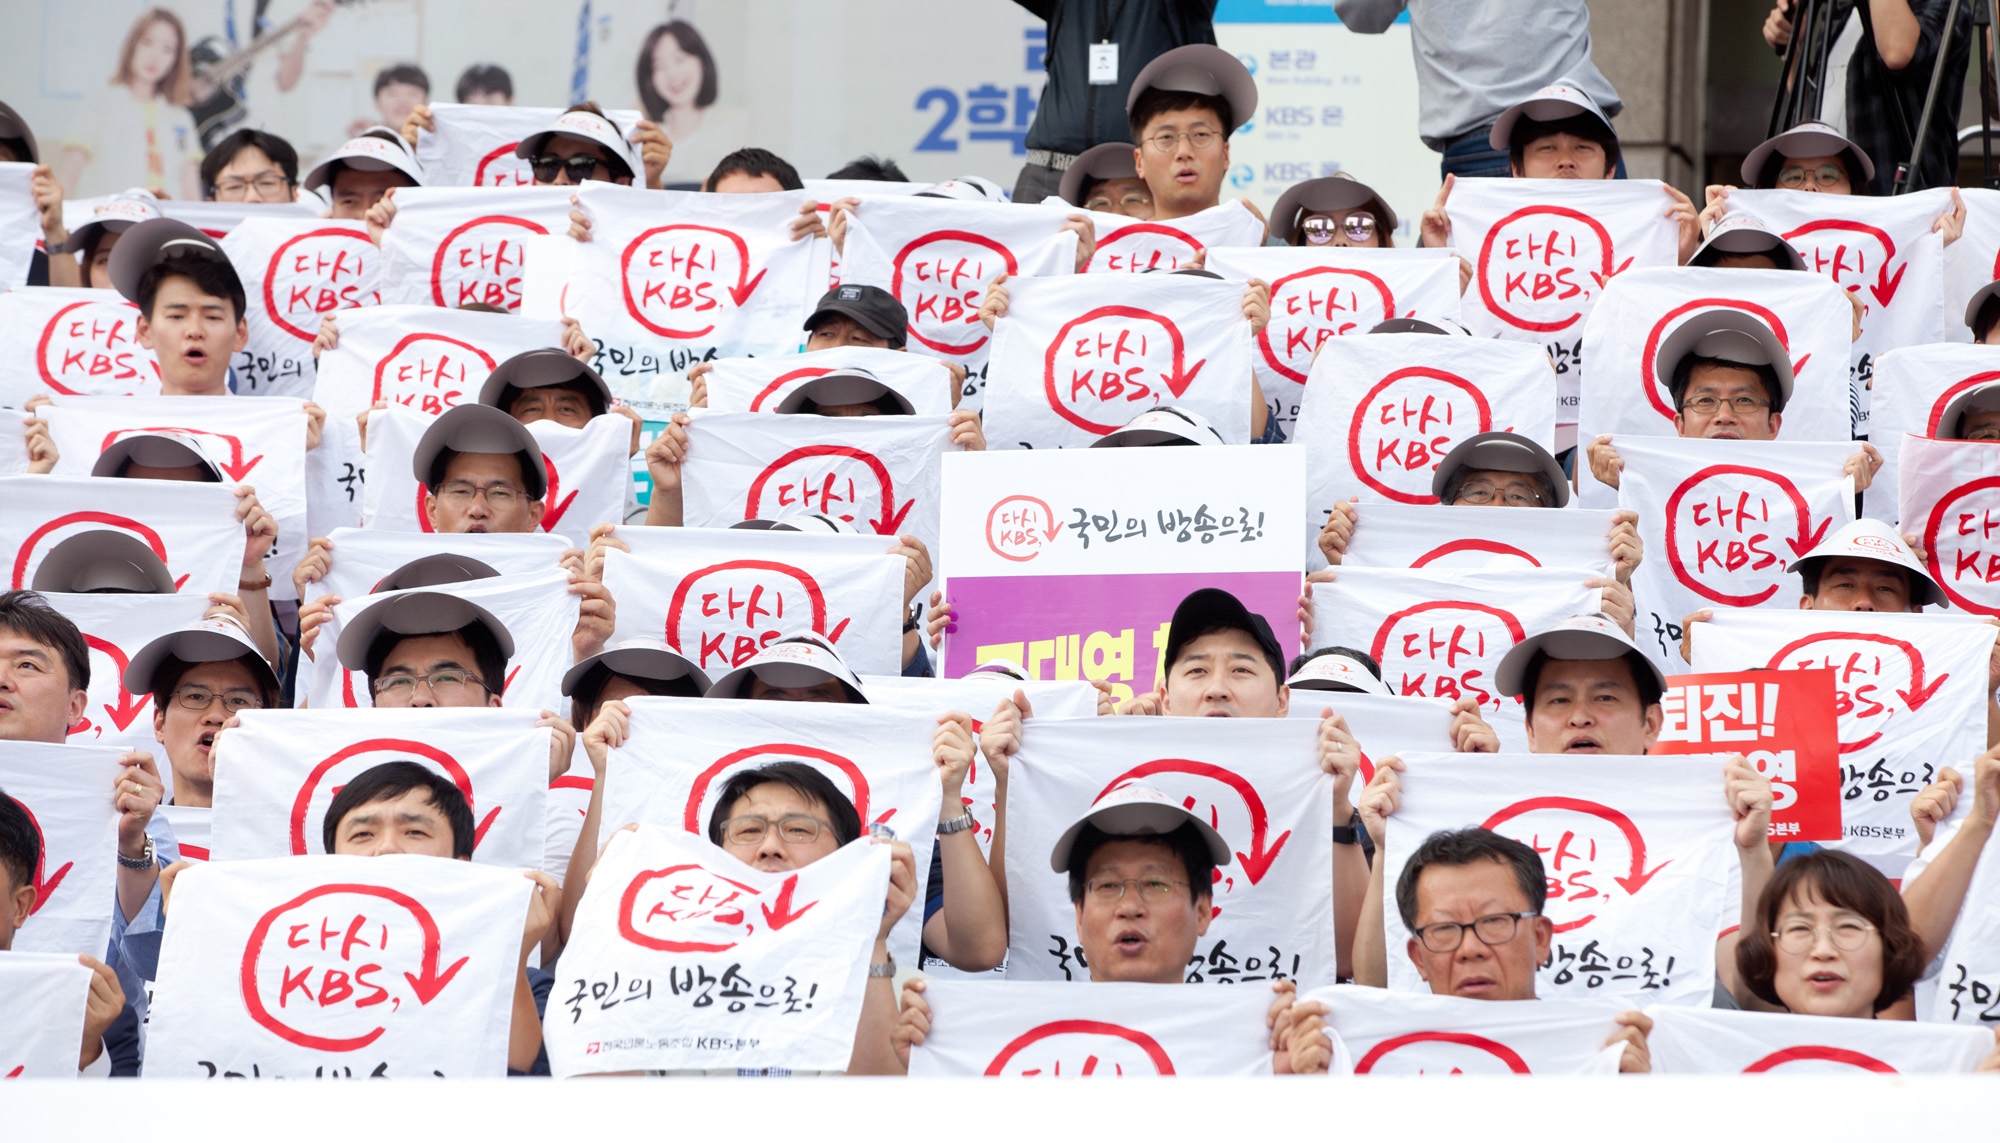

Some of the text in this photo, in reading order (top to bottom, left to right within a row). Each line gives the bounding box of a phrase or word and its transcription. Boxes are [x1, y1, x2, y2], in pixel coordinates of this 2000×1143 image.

[1269, 50, 1316, 70] 본관
[1265, 106, 1314, 126] KBS
[1263, 162, 1313, 182] KBS
[295, 250, 362, 283] 다시
[460, 240, 523, 276] 다시
[649, 243, 715, 279] 다시
[1506, 230, 1576, 267] 다시
[916, 258, 982, 290] 다시
[1505, 267, 1591, 302] KBS,
[460, 278, 522, 310] KBS
[642, 280, 723, 313] KBS,
[1287, 287, 1357, 321] 다시
[592, 338, 660, 376] 국민의
[1075, 329, 1147, 365] 다시
[62, 349, 146, 383] KBS,
[238, 351, 301, 390] 국민의
[398, 354, 465, 389] 다시
[1071, 366, 1160, 405] KBS,
[1381, 394, 1452, 435] 다시
[779, 472, 855, 515] 다시
[1001, 507, 1037, 527] 다시
[1068, 504, 1265, 550] 국민의 방송으로!
[1692, 490, 1769, 534] 다시
[1000, 529, 1042, 548] KBS,
[1697, 533, 1787, 574] KBS,
[1955, 548, 2000, 583] KB
[702, 584, 783, 629] 다시
[1403, 624, 1484, 669] 다시
[1657, 683, 1780, 743] 퇴진!
[1836, 684, 1895, 720] BS,
[1767, 822, 1801, 837] S본부
[1851, 826, 1906, 841] KBS본부
[1546, 870, 1610, 904] BS,
[288, 914, 387, 961] 다시
[279, 963, 400, 1013] KBS,
[565, 963, 818, 1025] 국민의 방송으로!
[697, 1036, 760, 1052] KBS본부
